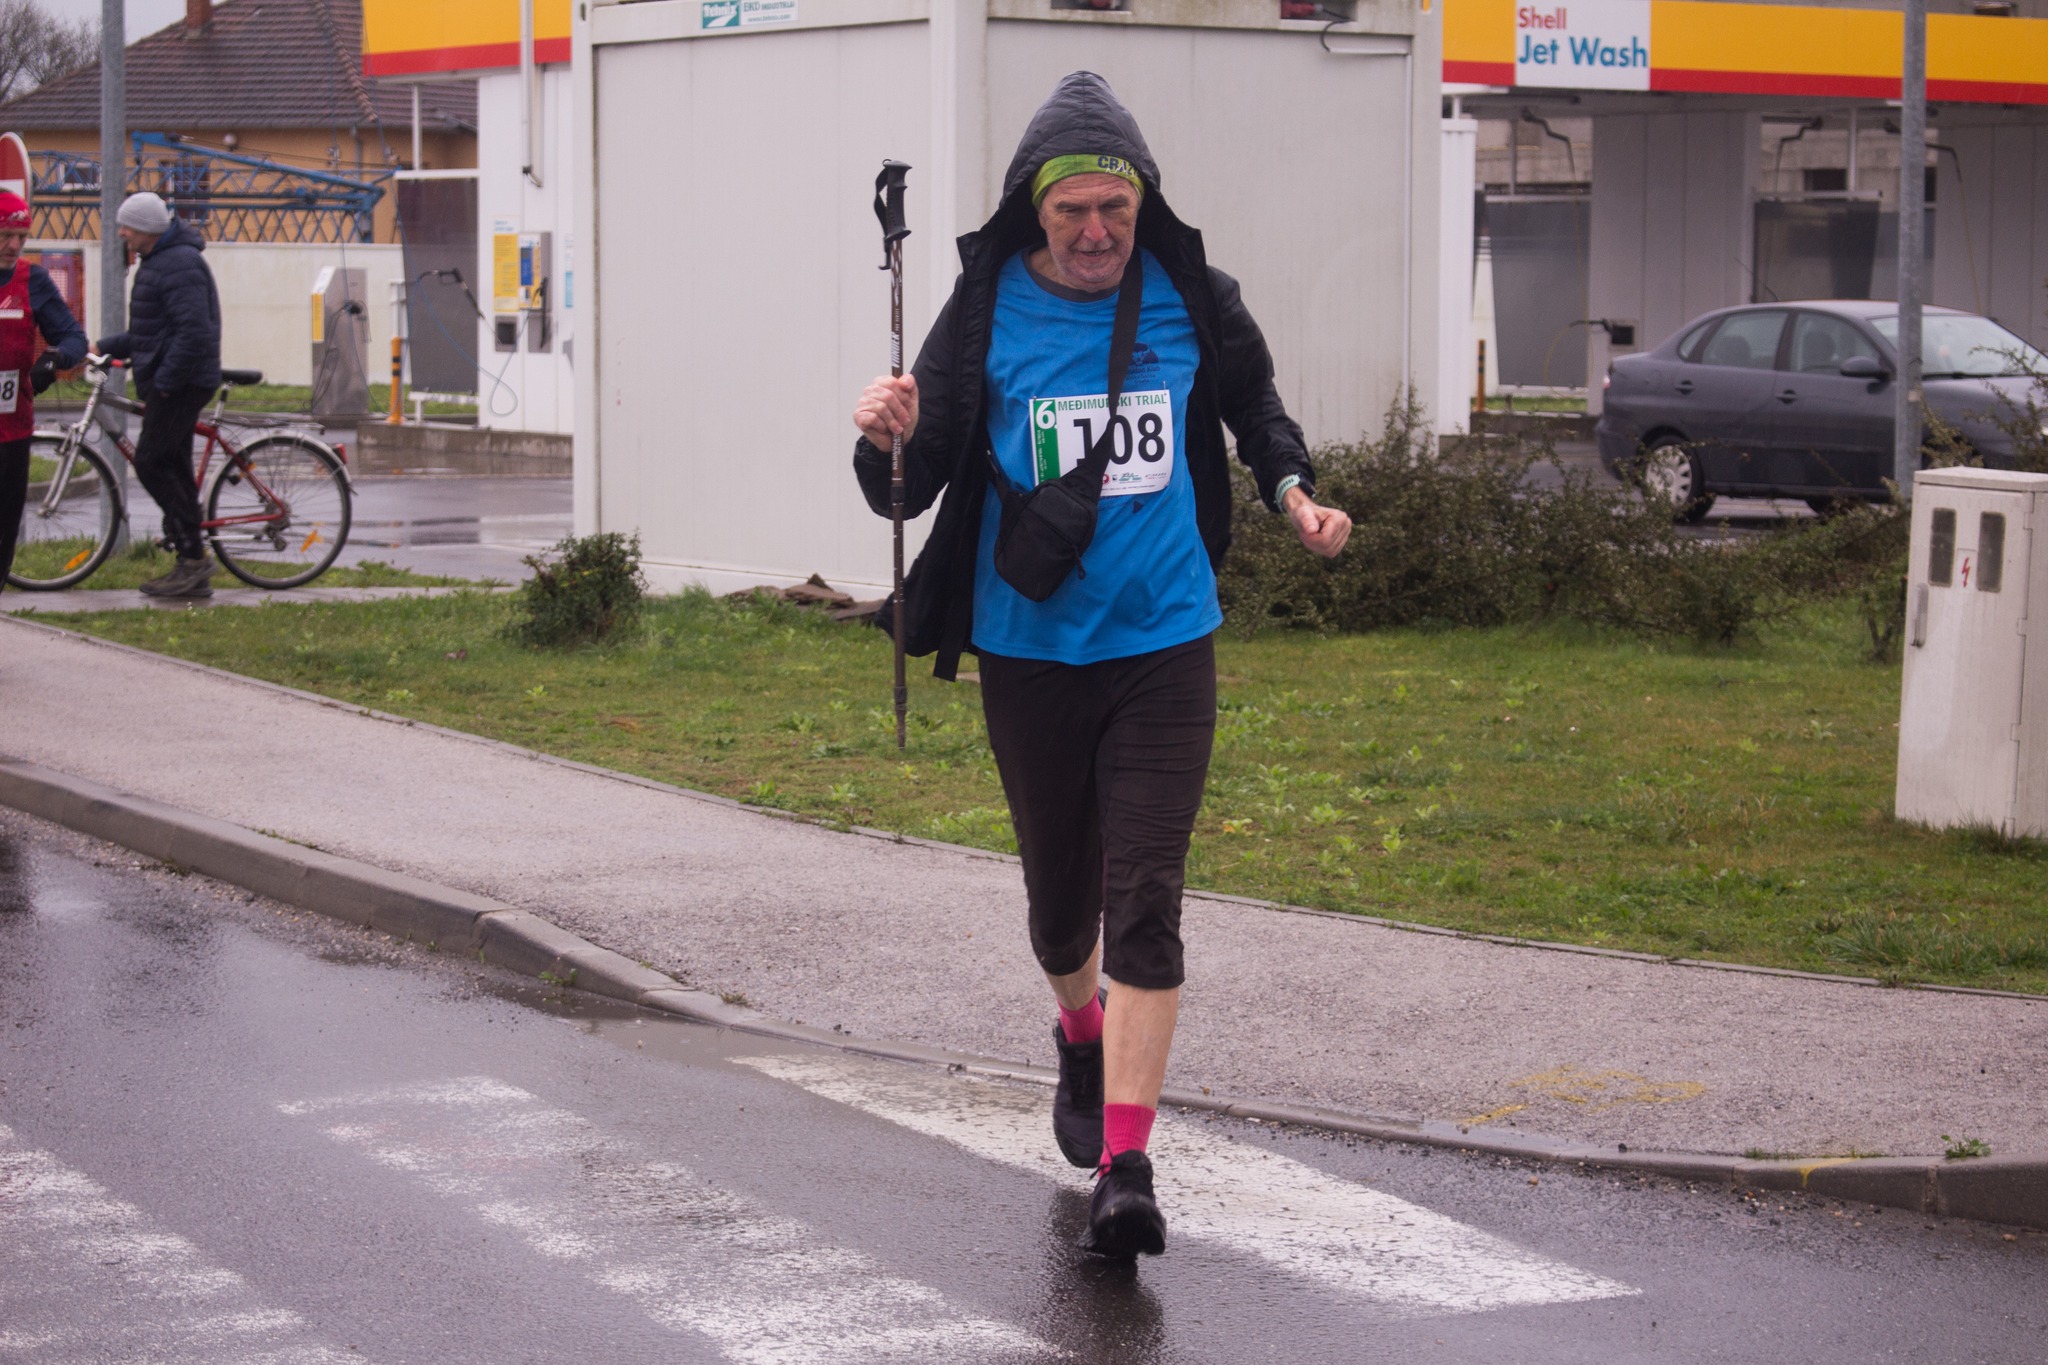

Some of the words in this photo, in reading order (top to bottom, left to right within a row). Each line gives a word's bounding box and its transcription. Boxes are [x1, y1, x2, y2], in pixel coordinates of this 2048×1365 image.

[1519, 7, 1567, 29] Shell
[1518, 35, 1559, 64] Jet
[1569, 36, 1648, 67] Wash
[1058, 399, 1132, 411] MEĐIMUKI
[1135, 394, 1168, 406] TRIAL
[1073, 412, 1165, 468] 108
